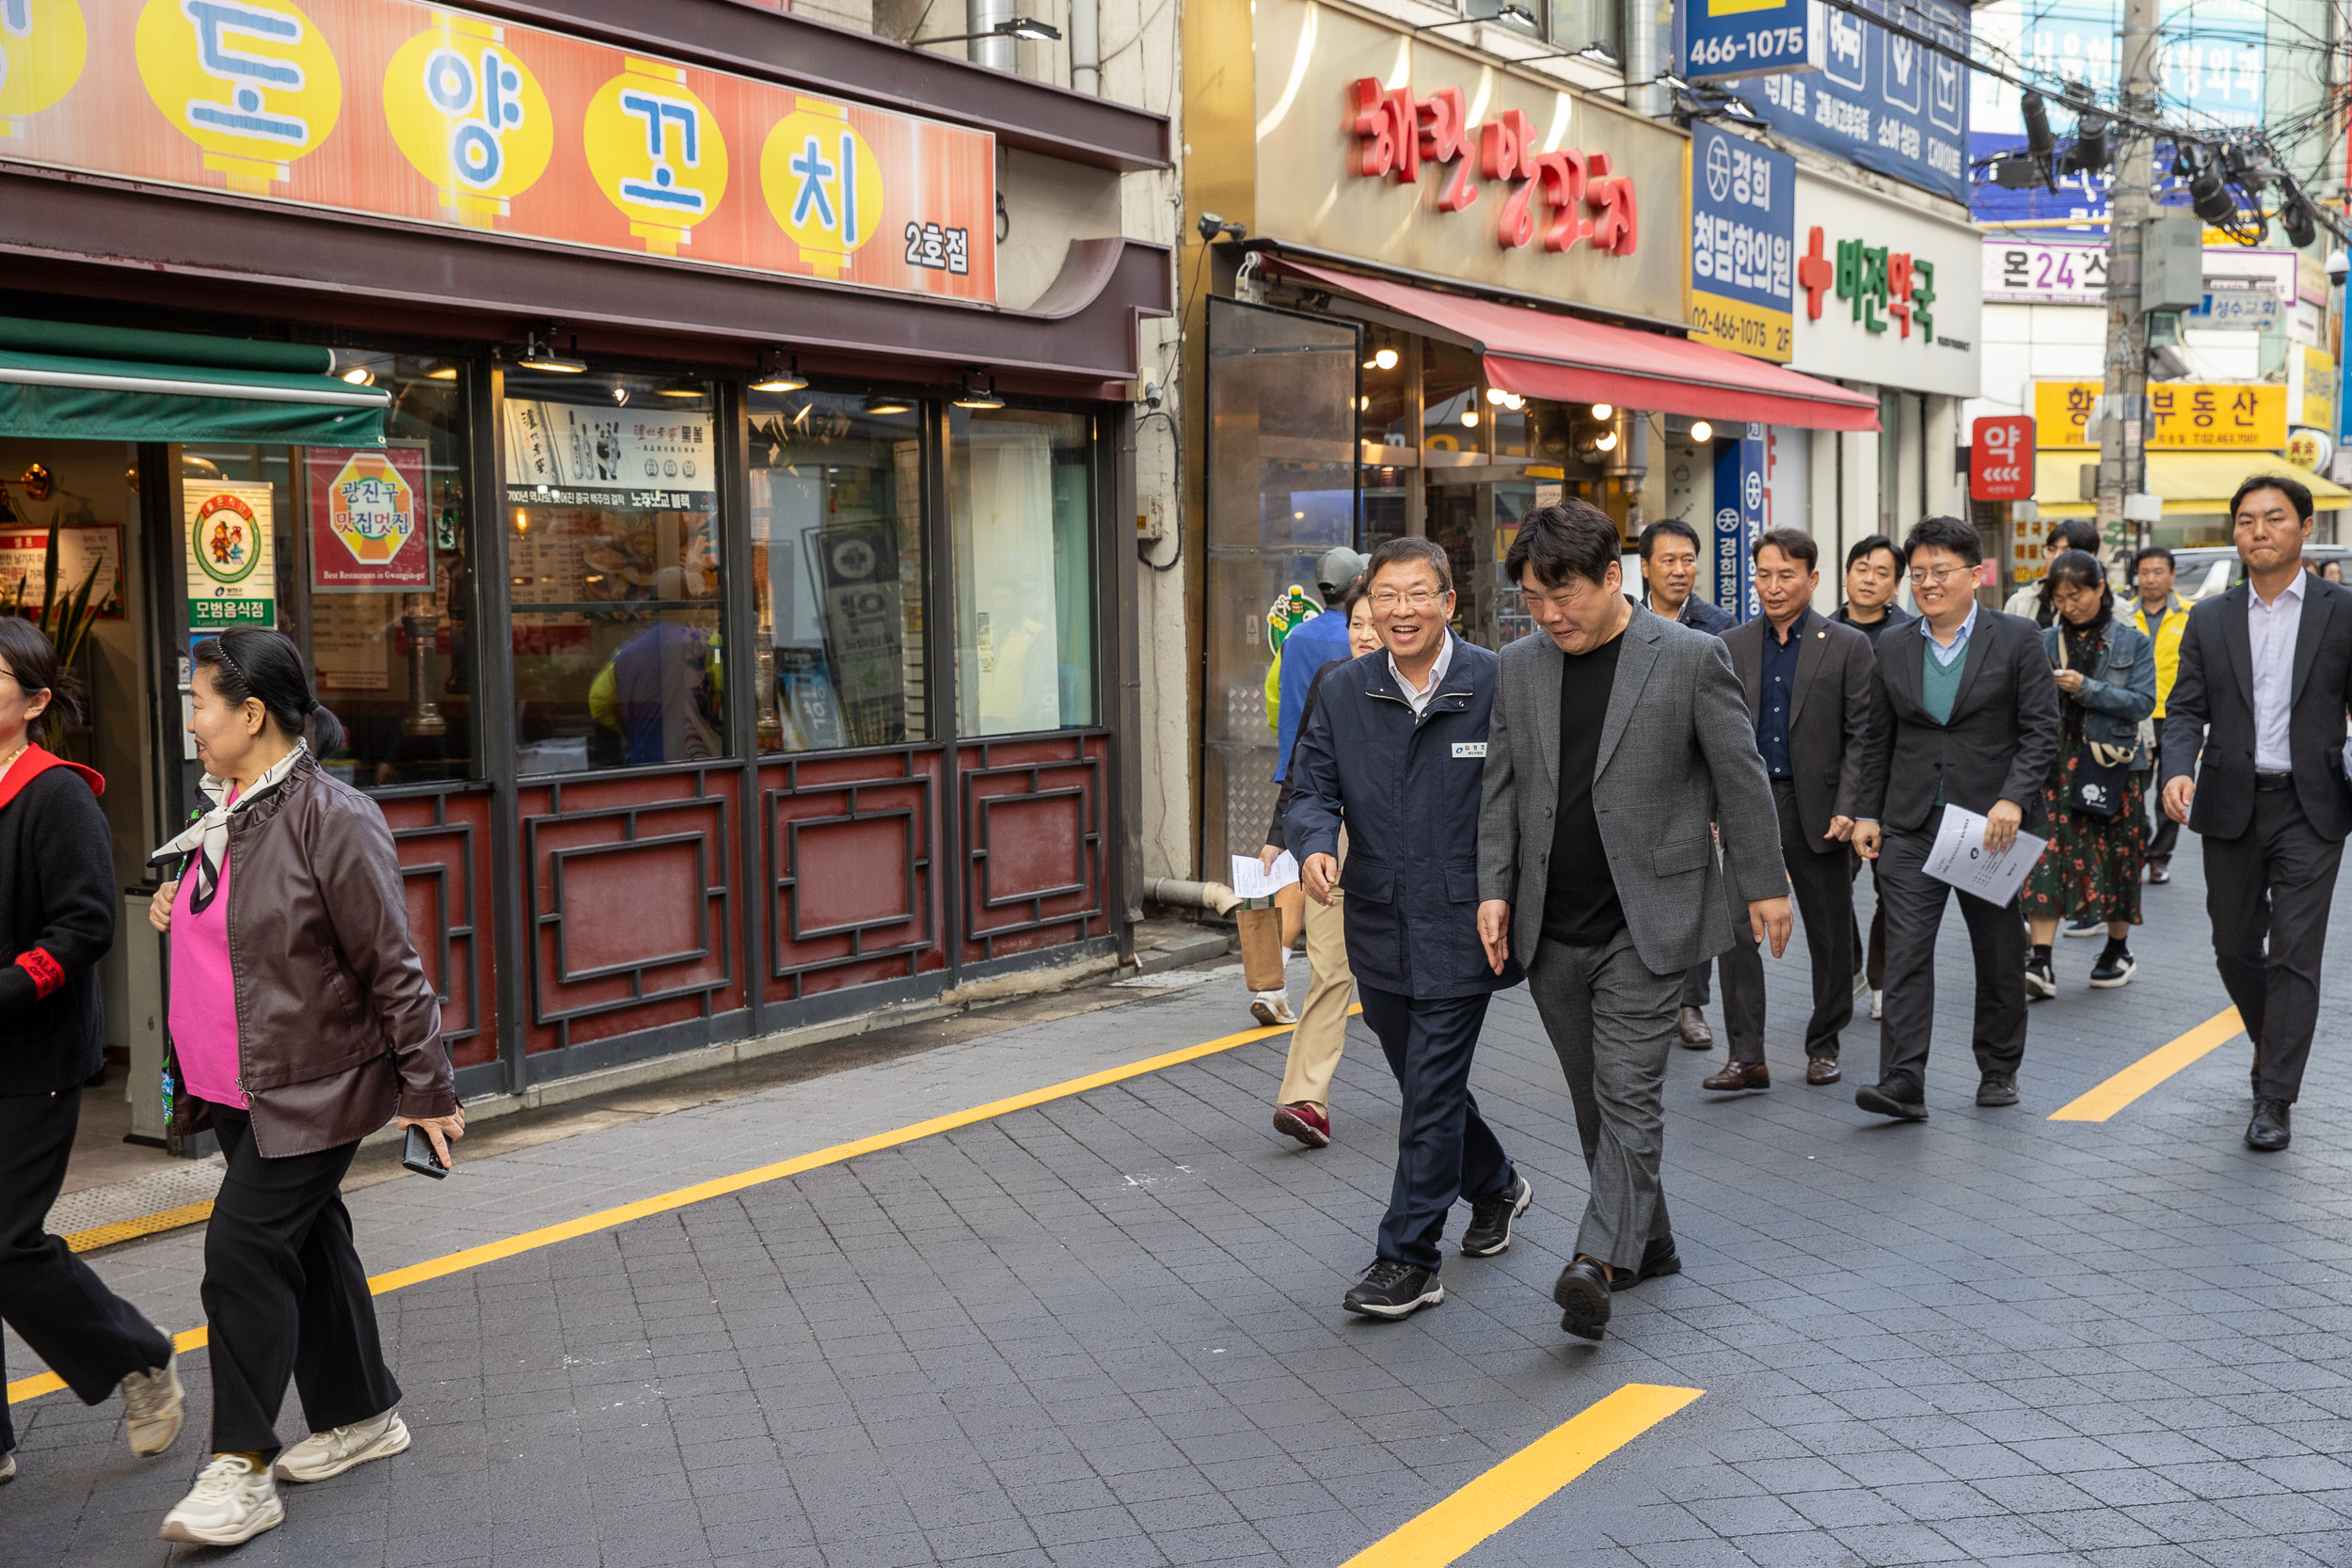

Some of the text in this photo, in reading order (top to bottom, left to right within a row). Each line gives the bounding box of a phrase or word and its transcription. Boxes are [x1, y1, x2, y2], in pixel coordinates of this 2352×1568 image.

[1691, 26, 1804, 65] 466-1075
[0, 0, 858, 247] 도양꼬치
[1733, 149, 1771, 212] 경희
[905, 221, 968, 276] 2호점
[1694, 211, 1790, 299] 청담한의원
[2215, 300, 2277, 318] 성수교회
[1693, 306, 1790, 352] 02-466-1075 2F
[2066, 387, 2259, 427] 황부동산
[1984, 424, 2022, 464] 약
[342, 481, 399, 504] 광진구
[575, 492, 590, 506] 중국
[671, 493, 691, 509] 블랙
[336, 511, 408, 535] 맛집멋집
[324, 570, 425, 581] Best Restaurants in Gwangjin-gu
[196, 601, 264, 619] 모범음식점
